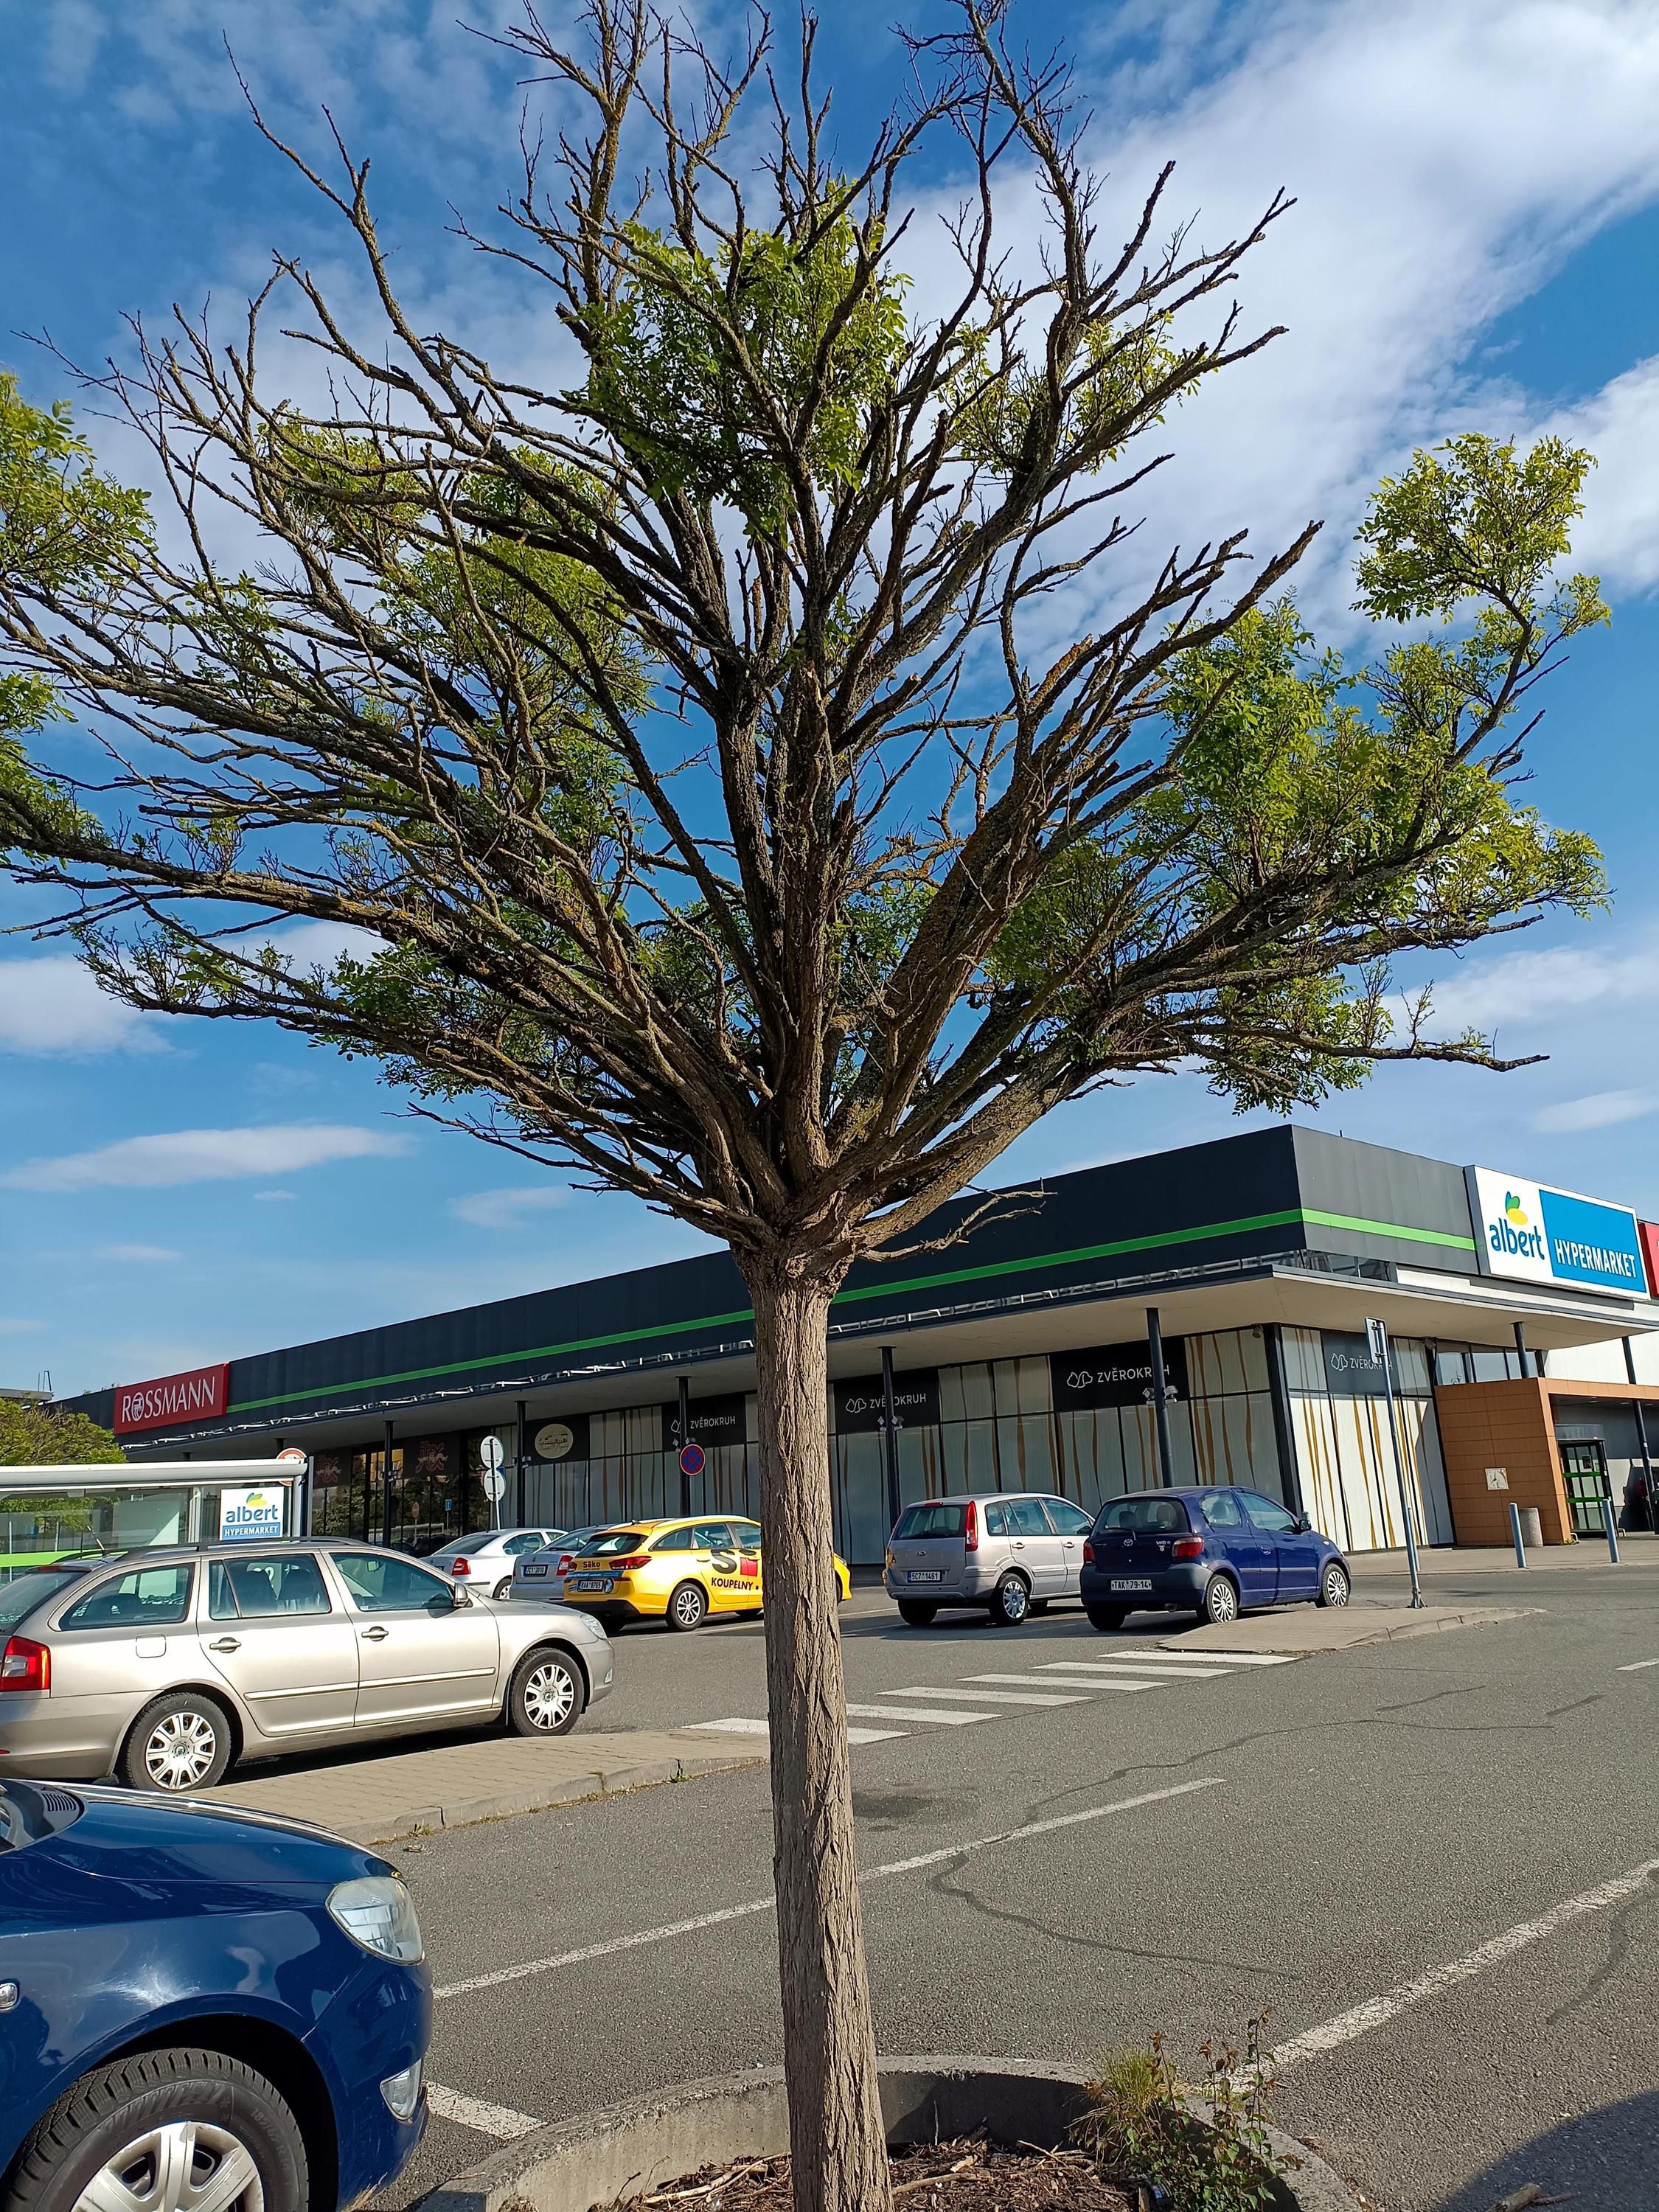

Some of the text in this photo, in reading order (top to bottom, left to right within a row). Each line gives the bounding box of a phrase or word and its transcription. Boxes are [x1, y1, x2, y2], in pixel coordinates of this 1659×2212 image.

[1489, 1217, 1637, 1278] albert HYPERMARKET
[1097, 1365, 1169, 1382] ZVĚROKRH
[122, 1376, 215, 1423] ROSSMANN
[869, 1393, 927, 1409] ZVĚOKRUH
[690, 1416, 736, 1430] ZVĚROKRUH
[226, 1504, 278, 1523] albert
[224, 1526, 278, 1537] HYPERMARKET
[711, 1576, 754, 1590] KOUPELNY
[1114, 1581, 1125, 1589] TAK
